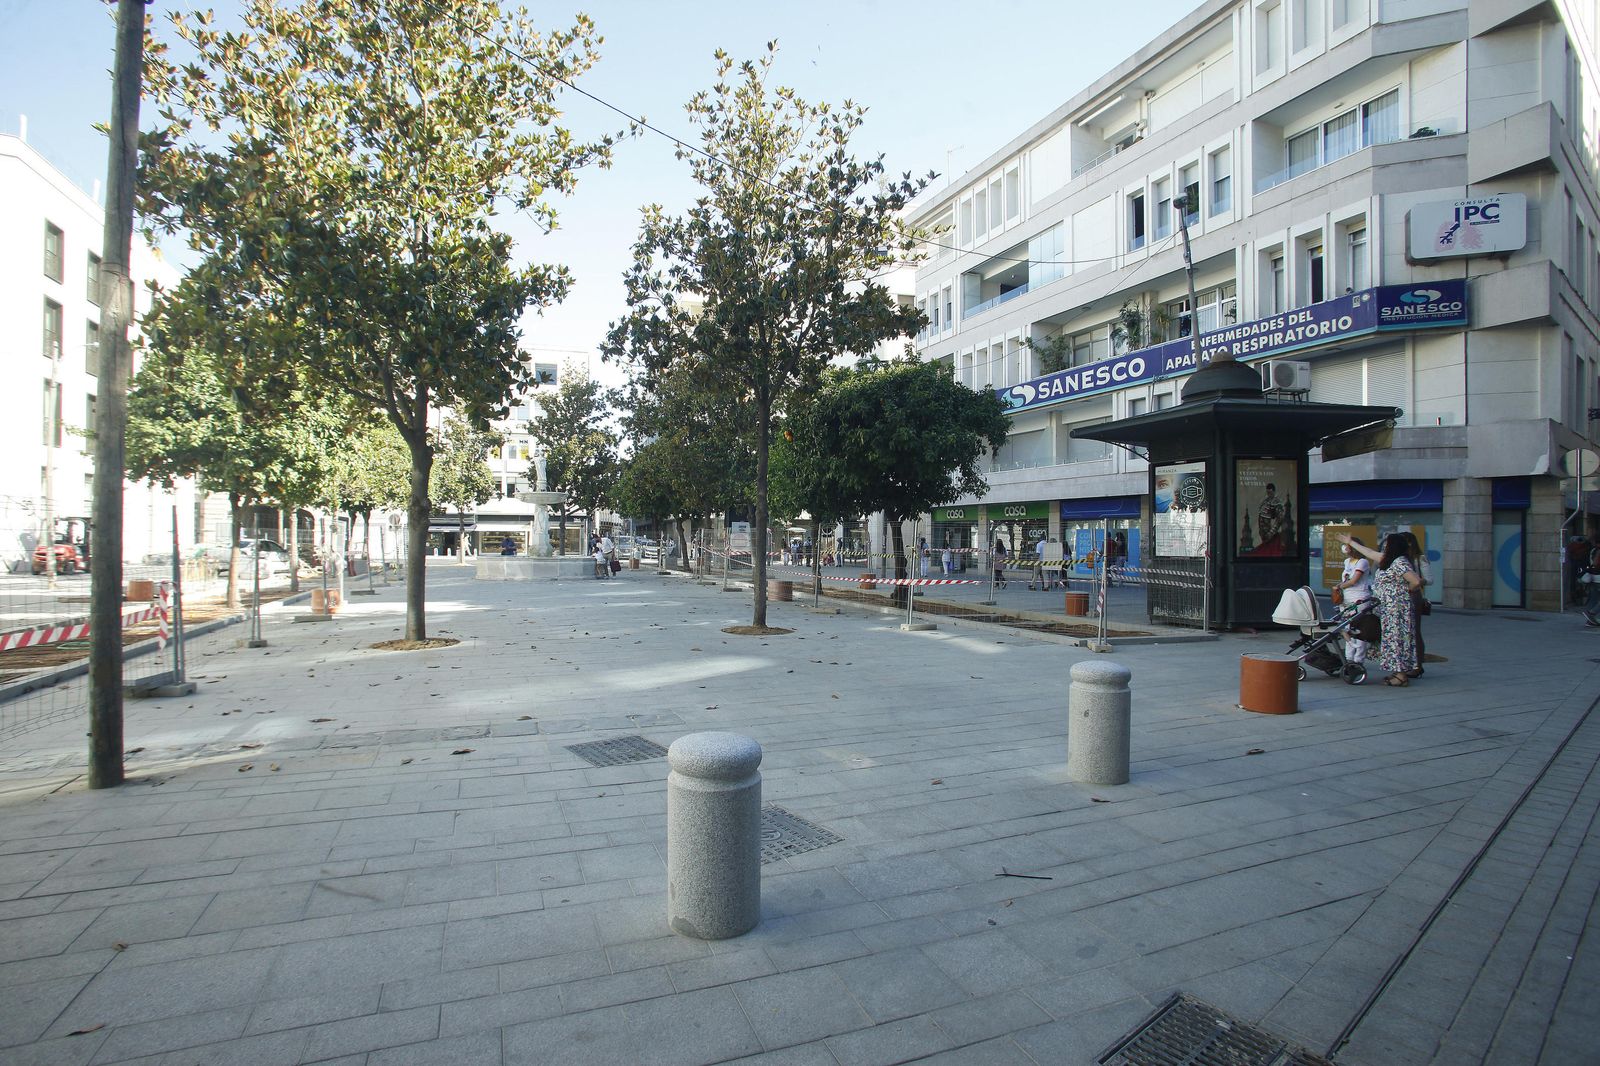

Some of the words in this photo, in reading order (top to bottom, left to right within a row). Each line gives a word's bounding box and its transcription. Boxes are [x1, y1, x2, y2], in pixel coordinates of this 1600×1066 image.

[1452, 203, 1500, 225] JPC
[1454, 197, 1500, 206] CONSULTA
[1381, 301, 1462, 316] SANESCO
[1191, 318, 1284, 350] ENFERMEDADES
[1288, 310, 1314, 326] DEL
[1232, 316, 1352, 356] RESPIRATORIO
[1038, 358, 1146, 399] SANESCO
